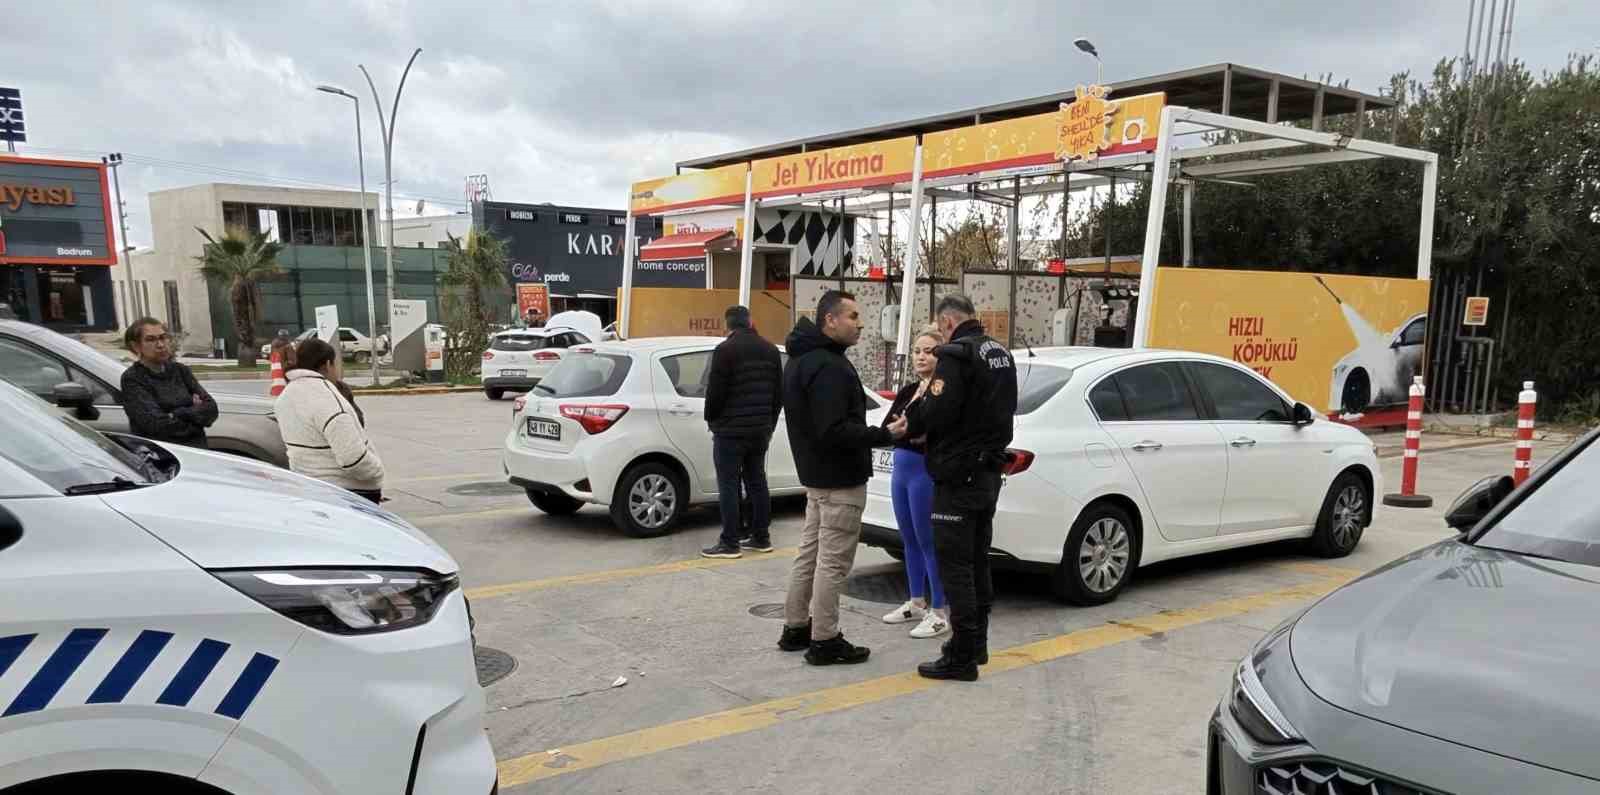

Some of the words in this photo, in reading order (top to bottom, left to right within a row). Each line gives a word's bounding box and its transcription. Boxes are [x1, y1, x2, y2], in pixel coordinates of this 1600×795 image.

[1061, 112, 1104, 138] SHELL'DE
[772, 162, 798, 187] Jet
[804, 152, 884, 182] Yıkama
[56, 247, 92, 257] Bodrum
[637, 260, 664, 271] home
[666, 261, 705, 274] concept
[544, 271, 570, 283] perde
[1228, 317, 1264, 336] HIZLI
[1233, 337, 1298, 362] KÖPÜKLÜ
